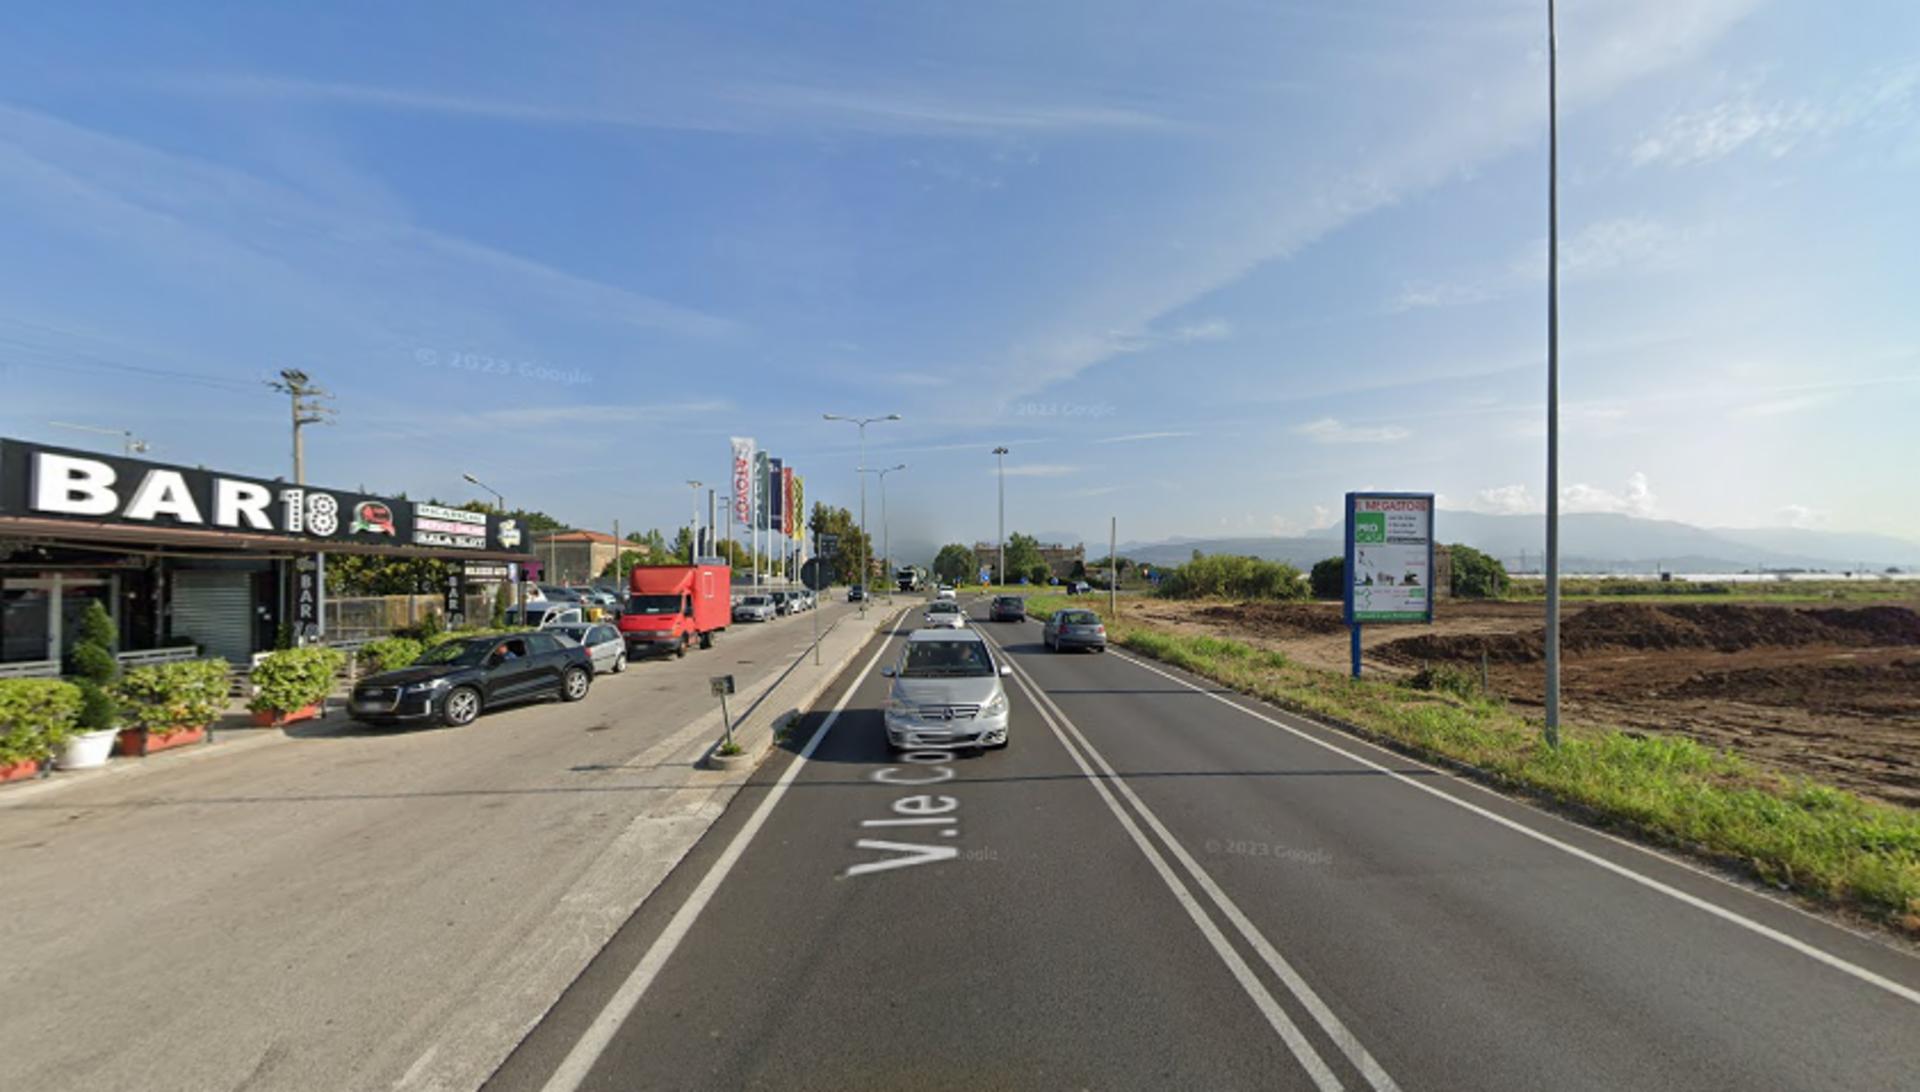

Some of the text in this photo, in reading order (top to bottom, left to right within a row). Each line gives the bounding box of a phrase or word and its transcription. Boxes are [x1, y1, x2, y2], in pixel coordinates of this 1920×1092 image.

[32, 452, 338, 536] BAR 18
[735, 457, 749, 523] TOYOTA
[1365, 500, 1428, 511] MEGASTORE
[299, 573, 313, 618] BAR
